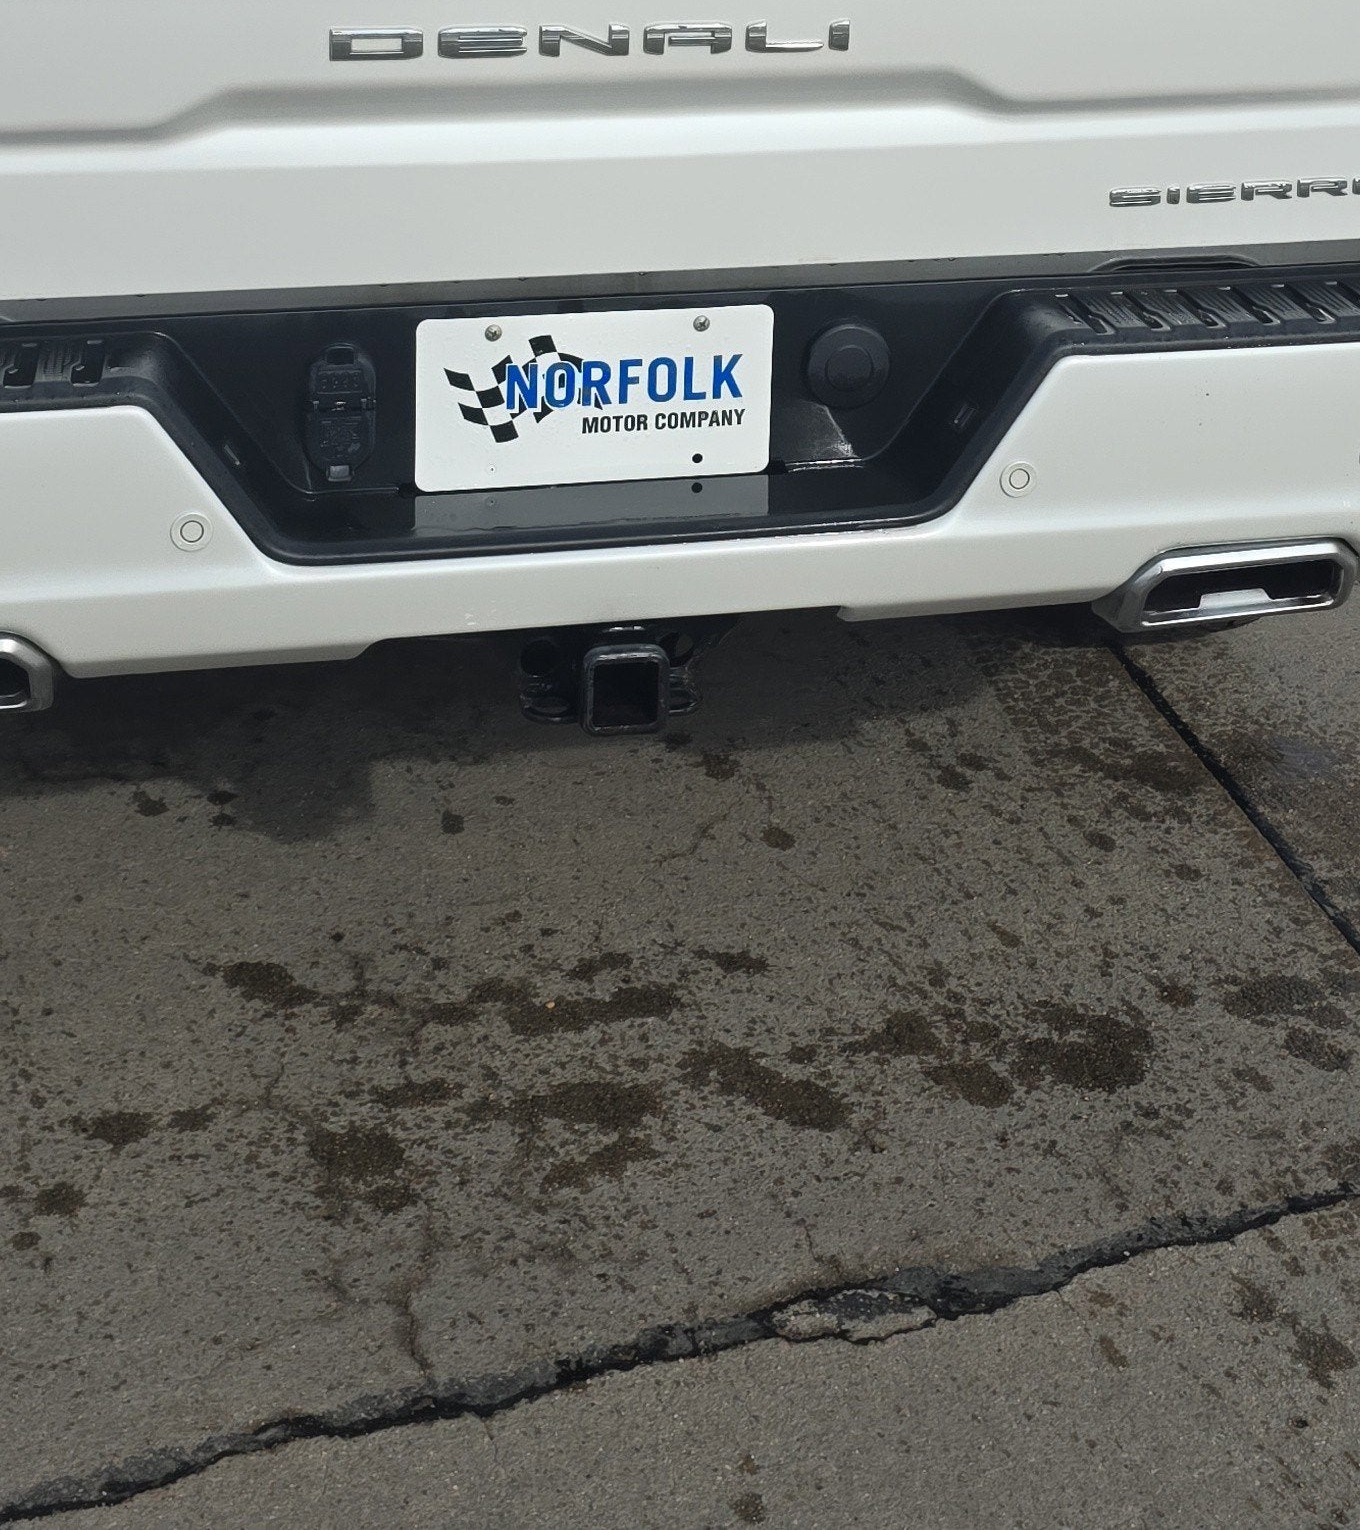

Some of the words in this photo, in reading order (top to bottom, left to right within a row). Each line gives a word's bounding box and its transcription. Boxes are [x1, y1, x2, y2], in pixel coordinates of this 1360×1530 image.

[329, 18, 850, 61] DENALI
[506, 354, 743, 410] NORFOLK
[581, 414, 648, 434] MOTOR
[654, 409, 746, 430] COMPANY
